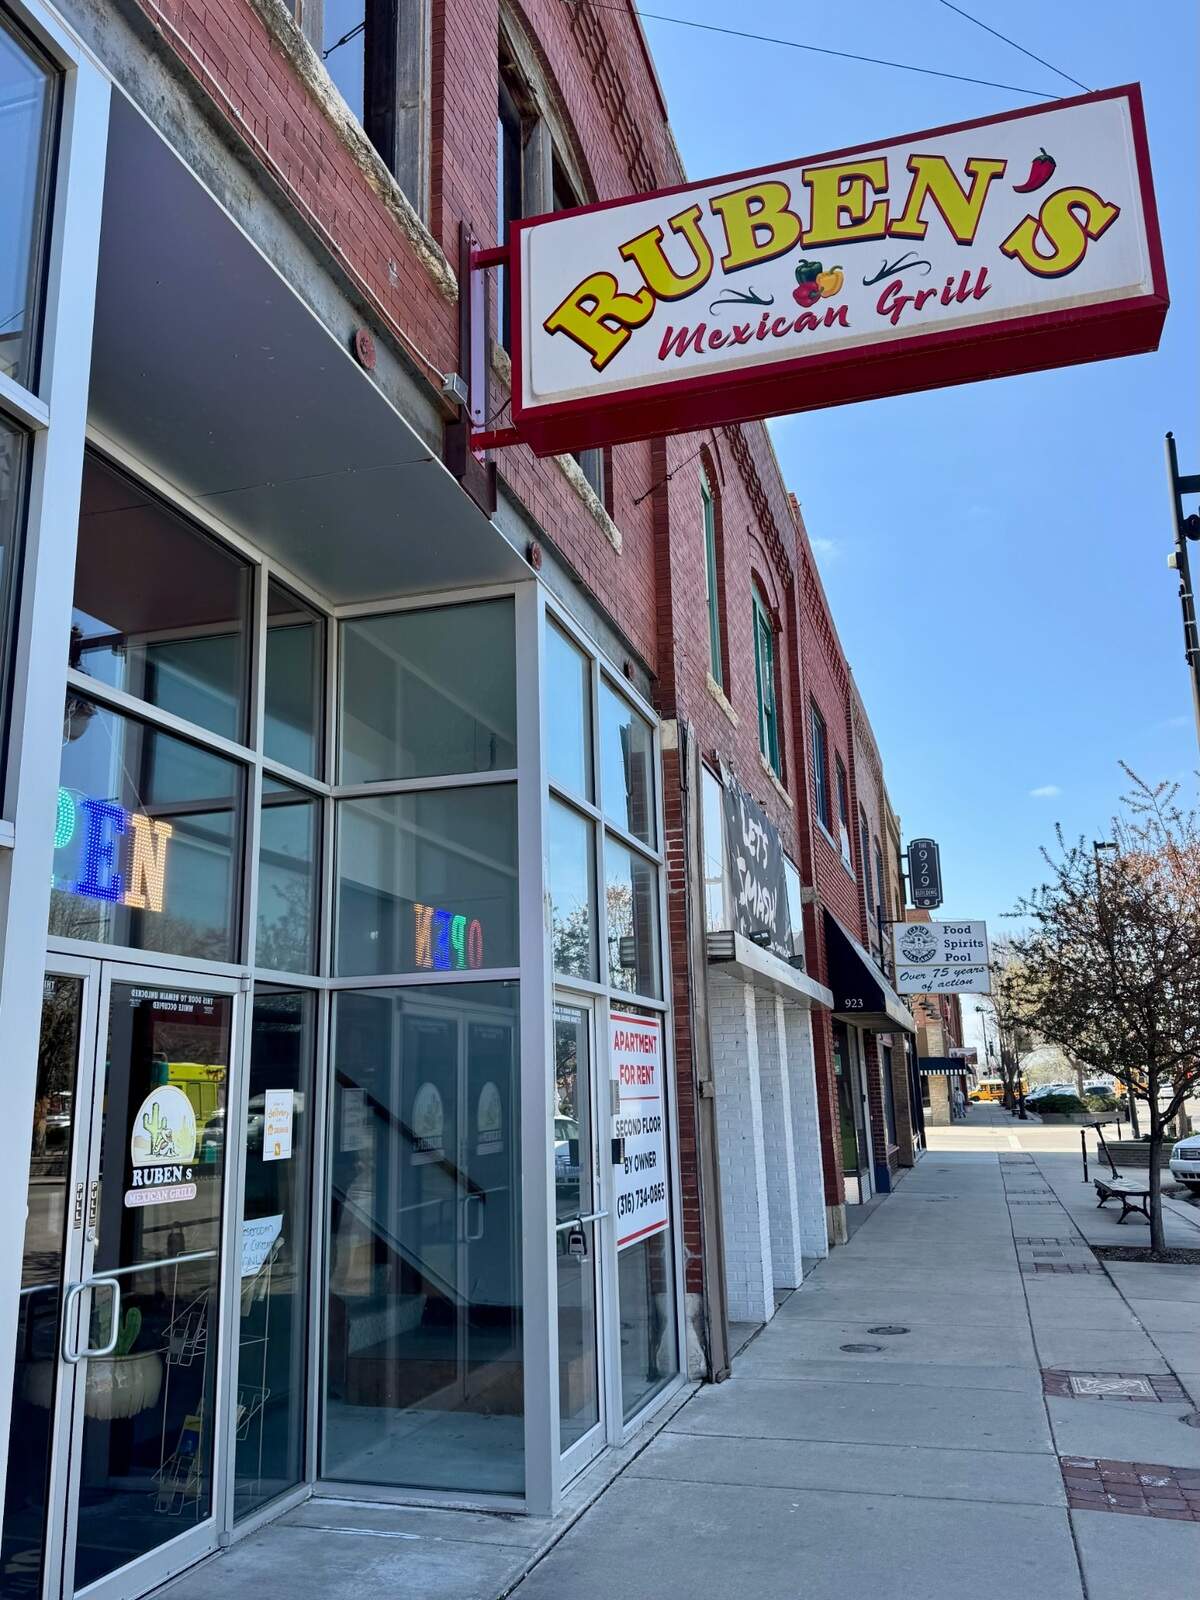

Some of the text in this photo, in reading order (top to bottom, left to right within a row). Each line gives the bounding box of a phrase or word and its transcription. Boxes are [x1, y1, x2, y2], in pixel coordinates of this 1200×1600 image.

[657, 265, 993, 362] Mexican Grill
[943, 925, 972, 935] Food
[943, 939, 984, 950] Spirits
[945, 953, 972, 962] Pool
[899, 965, 985, 982] Over 75 years
[921, 976, 975, 991] of action
[844, 999, 864, 1008] 923
[613, 1030, 657, 1055] APARTMENT
[619, 1064, 655, 1086] FOR RENT
[615, 1115, 662, 1138] SECOND FLOOR
[624, 1150, 657, 1175] BY OWNER
[75, 1183, 83, 1220] PULL
[90, 1181, 98, 1218] PULL
[127, 1189, 169, 1204] MEXICAN
[617, 1192, 635, 1219] (316)
